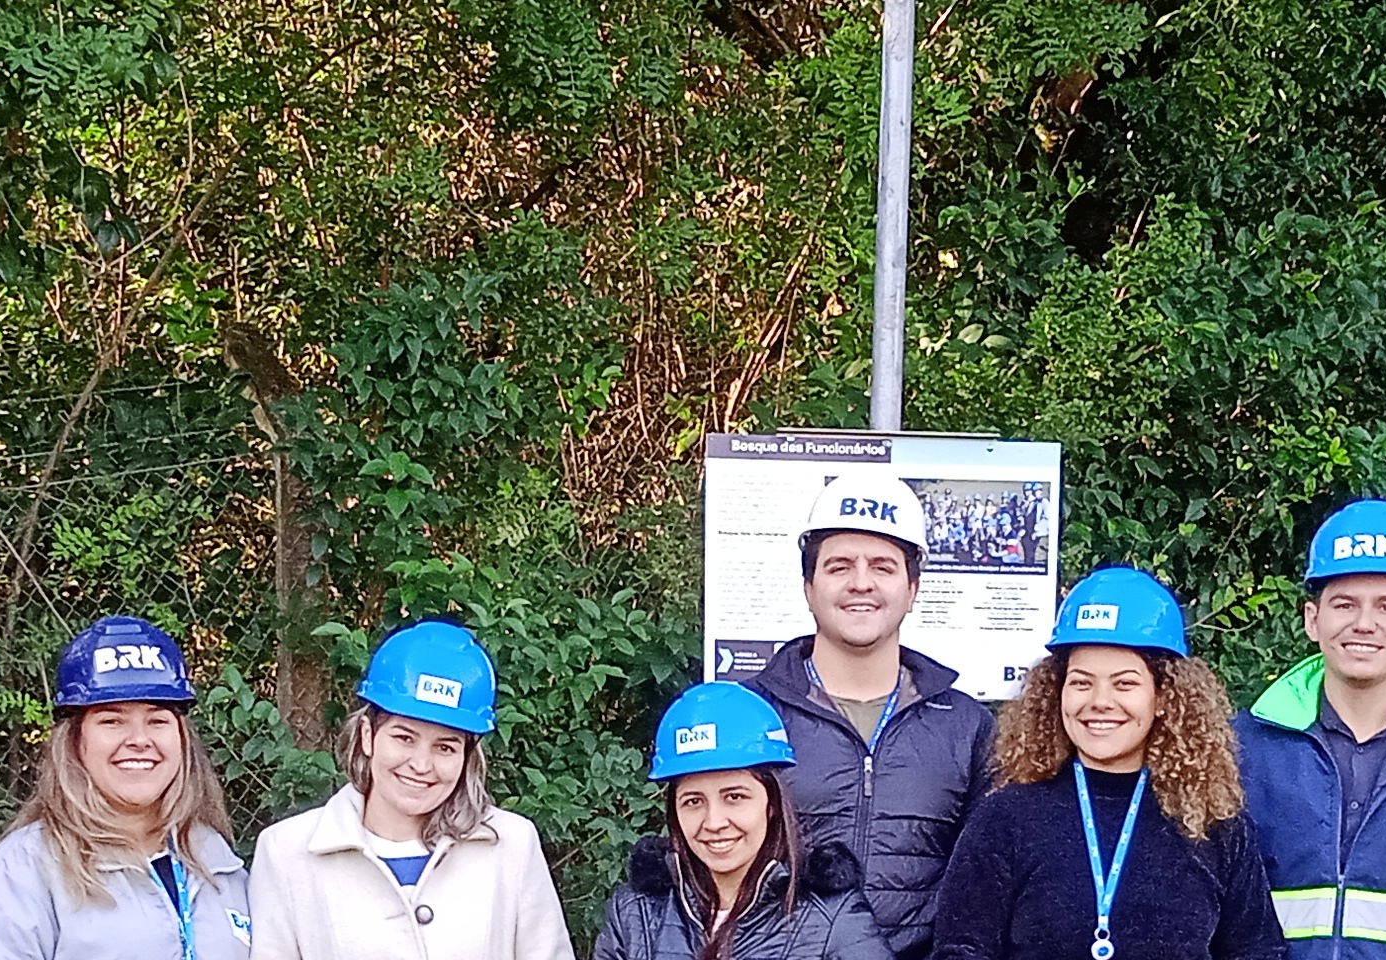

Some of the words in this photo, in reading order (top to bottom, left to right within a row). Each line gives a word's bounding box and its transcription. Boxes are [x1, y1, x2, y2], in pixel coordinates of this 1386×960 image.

[731, 440, 778, 453] Bosque
[840, 498, 898, 524] BRK
[93, 644, 165, 673] BRK
[422, 681, 458, 698] BRK
[679, 729, 709, 744] BRK
